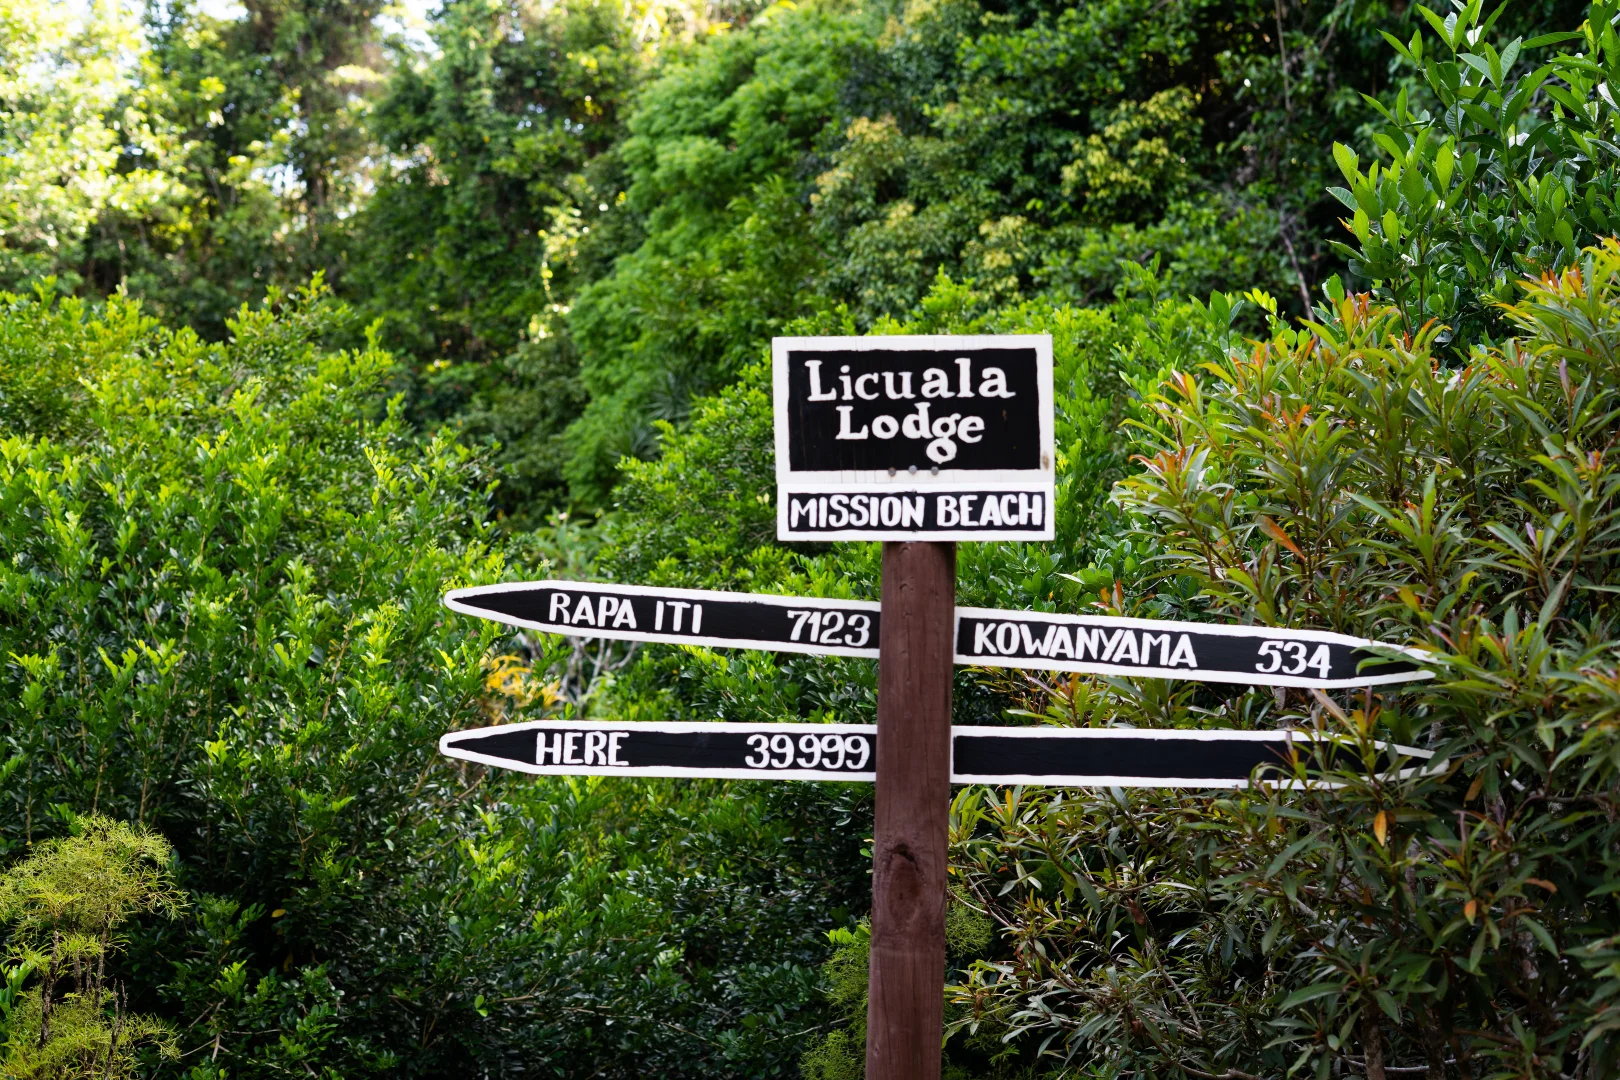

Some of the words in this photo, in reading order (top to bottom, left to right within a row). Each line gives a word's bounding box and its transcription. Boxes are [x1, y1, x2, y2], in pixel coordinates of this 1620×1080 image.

[805, 358, 1015, 401] Licuala
[836, 402, 984, 464] Lodge
[791, 495, 925, 528] MISSION
[937, 493, 1042, 526] BEACH
[549, 593, 636, 628] RAPA
[655, 601, 702, 633] ITI
[787, 610, 870, 646] 7123
[974, 622, 1197, 667] KOWANYAMA
[1256, 641, 1332, 678] 534
[536, 731, 630, 766] HERE
